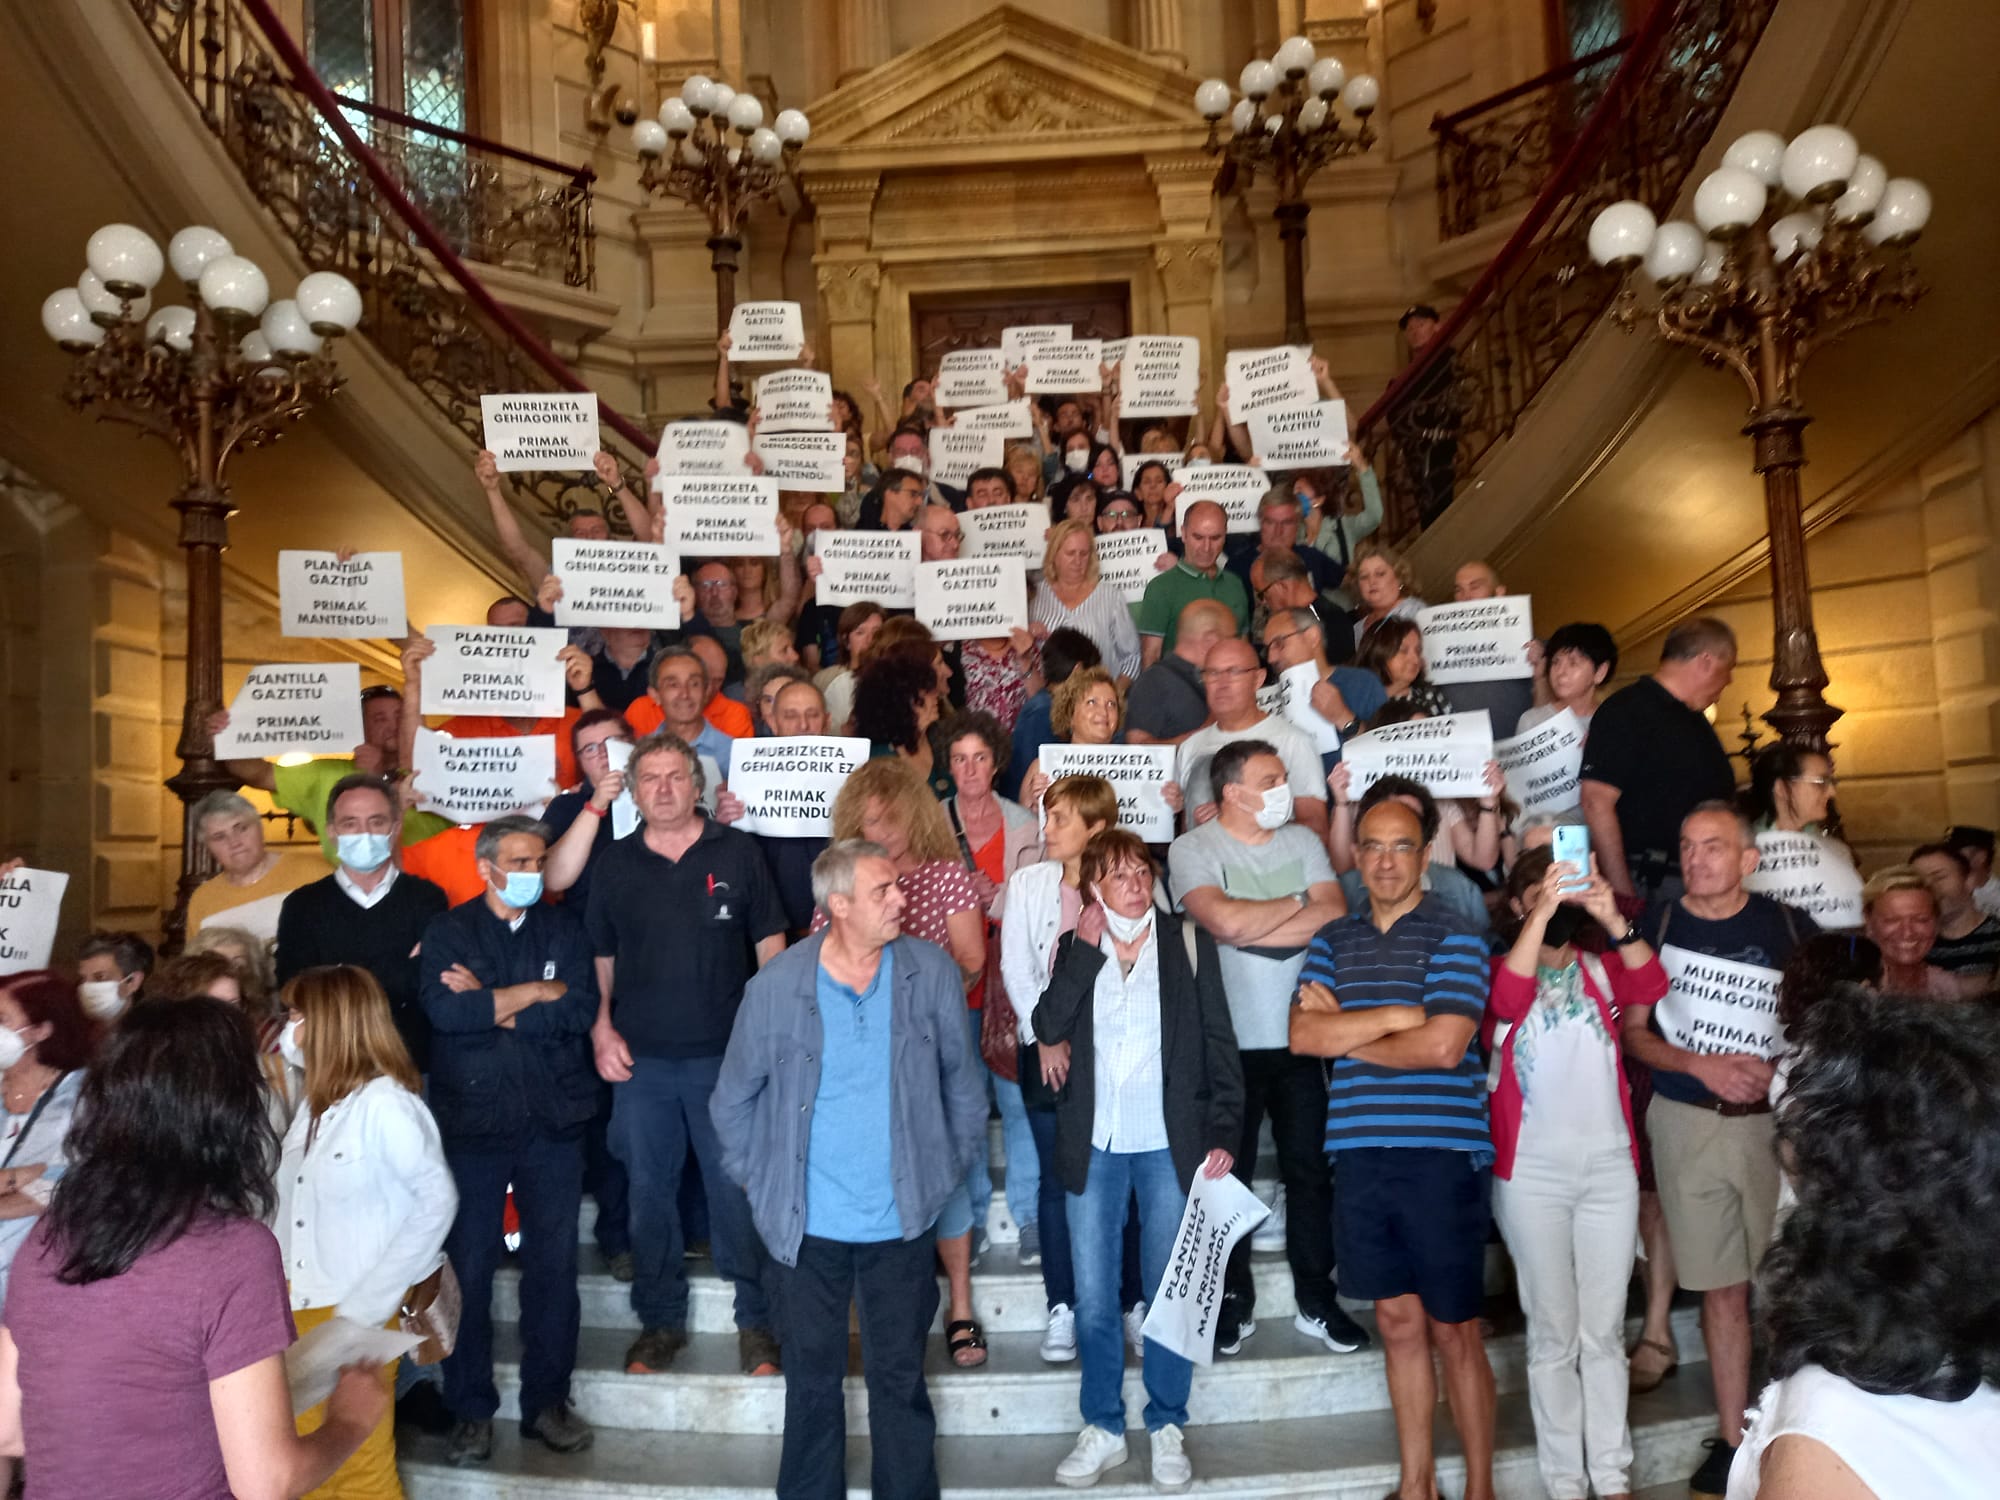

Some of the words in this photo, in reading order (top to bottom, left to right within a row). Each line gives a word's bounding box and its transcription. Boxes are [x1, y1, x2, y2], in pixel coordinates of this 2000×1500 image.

[1143, 350, 1180, 358] GAZTETU
[1135, 362, 1180, 371] PLANTILLA
[1240, 352, 1291, 372] PLANTILLA
[1047, 368, 1079, 376] PRIMAK
[1137, 372, 1177, 380] GAZTETU
[1245, 362, 1289, 380] GAZTETU
[1140, 390, 1175, 398] PRIMAK
[1251, 380, 1290, 398] PRIMAK
[502, 402, 579, 411] MURRIZKETA
[494, 414, 572, 423] GEHIAGORIK
[576, 413, 589, 423] EZ
[976, 412, 1009, 420] PRIMAK
[1267, 409, 1324, 424] PLANTILLA
[1272, 420, 1320, 433] GAZTETU
[673, 429, 729, 437] PLANTILLA
[519, 436, 569, 446] PRIMAK
[676, 440, 726, 449] GAZTETU
[1278, 438, 1320, 450] PRIMAK
[680, 461, 723, 469] PRIMAK
[778, 460, 818, 468] PRIMAK
[1191, 471, 1252, 480] MURRIZKETA
[682, 484, 759, 493] MURRIZKETA
[673, 496, 750, 505] GEHIAGORIK
[754, 496, 768, 505] EZ
[974, 509, 1029, 521] PLANTILLA
[696, 519, 747, 528] PRIMAK
[979, 520, 1026, 532] GAZTETU
[833, 538, 903, 548] MURRIZKETA
[984, 540, 1025, 550] PRIMAK
[575, 548, 659, 560] MURRIZKETA
[824, 549, 895, 560] GEHIAGORIK
[899, 551, 912, 560] EZ
[1146, 545, 1158, 554] EZ
[304, 560, 373, 573] PLANTILLA
[565, 561, 650, 574] GEHIAGORIK
[654, 565, 669, 575] EZ
[937, 564, 1001, 578] PLANTILLA
[309, 574, 368, 587] GAZTETU
[844, 572, 891, 583] PRIMAK
[942, 578, 997, 590] GAZTETU
[590, 587, 646, 599] PRIMAK
[314, 600, 368, 611] PRIMAK
[947, 601, 996, 614] PRIMAK
[1504, 615, 1520, 627] EZ
[455, 632, 536, 645] PLANTILLA
[460, 645, 530, 659] GAZTETU
[1445, 641, 1497, 657] PRIMAK
[248, 673, 328, 685] PLANTILLA
[462, 673, 525, 685] PRIMAK
[251, 688, 322, 700] GAZTETU
[256, 716, 321, 728] PRIMAK
[1560, 731, 1577, 747] EZ
[439, 744, 524, 758] PLANTILLA
[753, 745, 845, 758] MURRIZKETA
[1063, 754, 1153, 766] MURRIZKETA
[1385, 752, 1450, 766] PRIMAK
[445, 760, 518, 773] GAZTETU
[741, 761, 834, 773] GEHIAGORIK
[839, 763, 855, 774] EZ
[1148, 770, 1164, 781] EZ
[449, 786, 514, 798] PRIMAK
[764, 789, 826, 803] PRIMAK
[1758, 854, 1820, 872] AZTETU
[1670, 977, 1779, 1015] GEHIAGORI
[1693, 1019, 1773, 1048] PRIMAK
[1165, 1197, 1200, 1301] PLANTILLA
[1179, 1209, 1206, 1299] GAZTETU
[1196, 1225, 1220, 1305] PRIMAK
[1197, 1212, 1242, 1337] MANTENDU!!!
